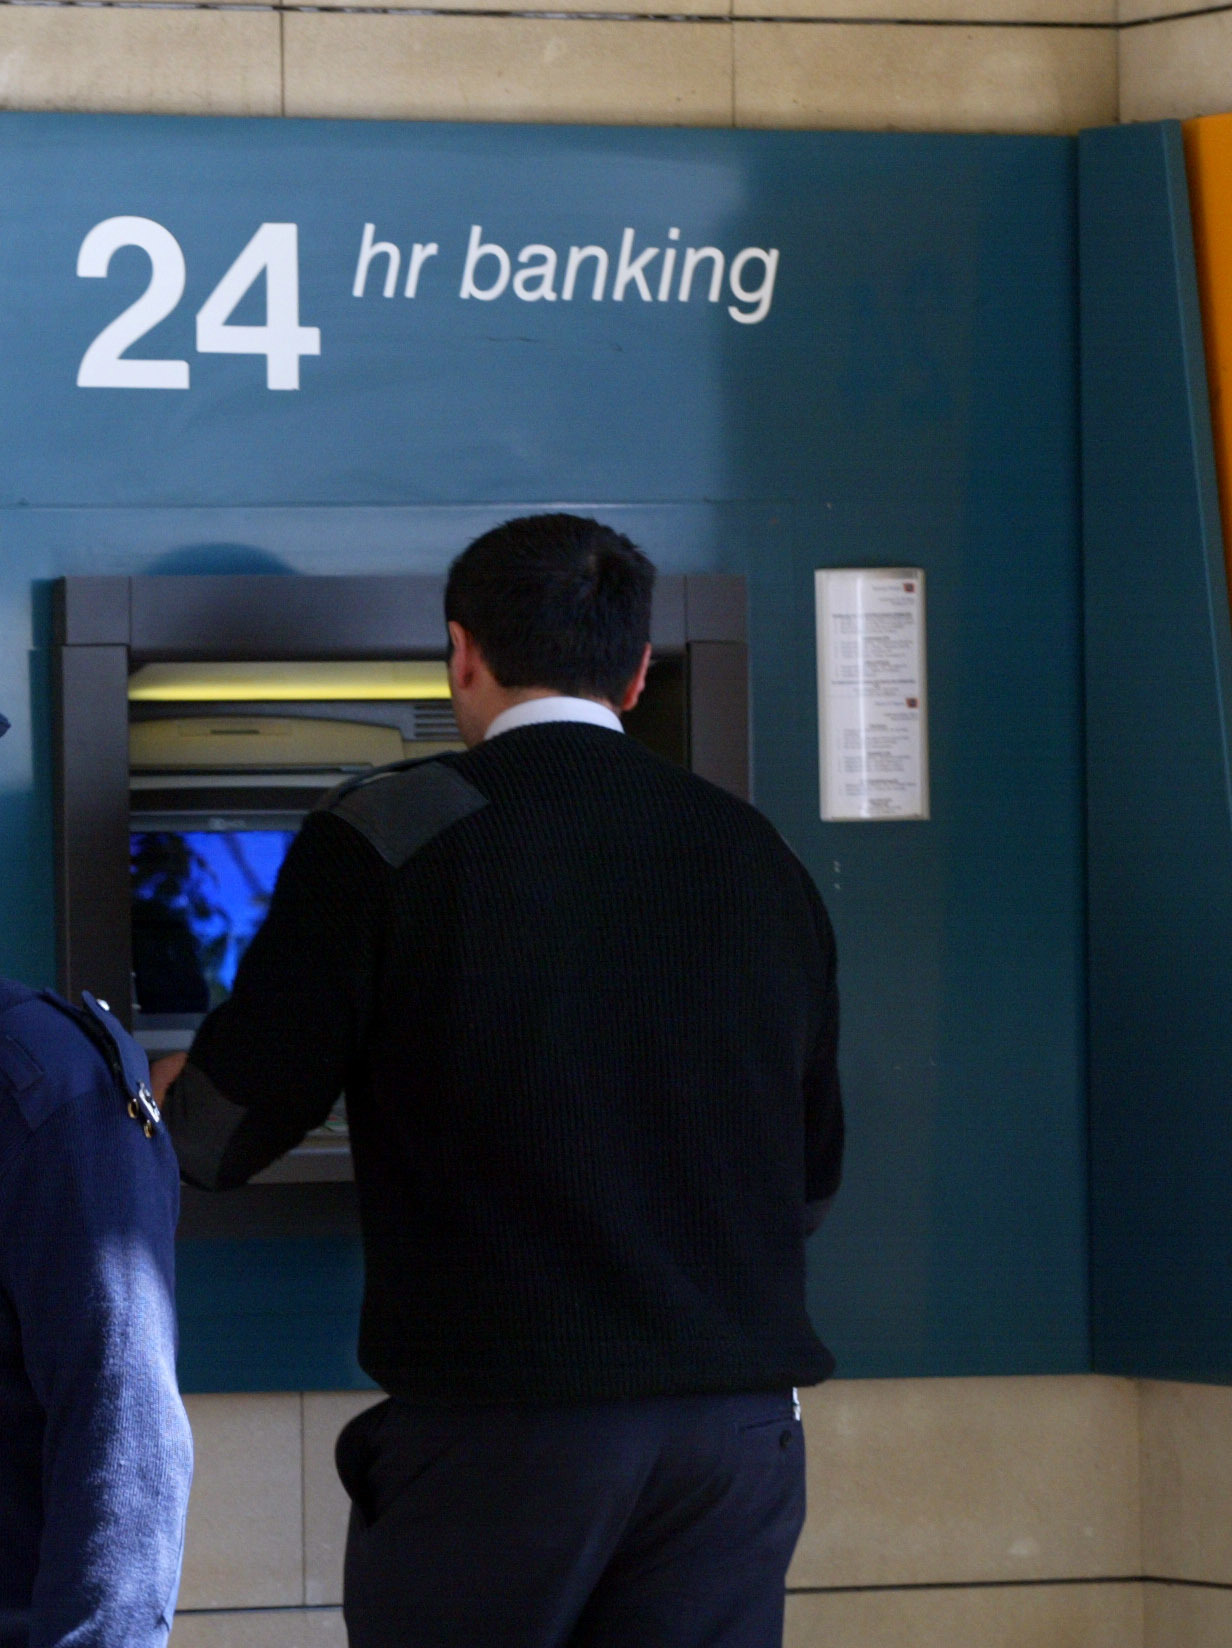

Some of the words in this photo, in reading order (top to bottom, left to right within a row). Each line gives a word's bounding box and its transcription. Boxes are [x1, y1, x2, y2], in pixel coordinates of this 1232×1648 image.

[77, 215, 320, 390] 24
[353, 223, 438, 298] hr
[460, 226, 779, 324] banking
